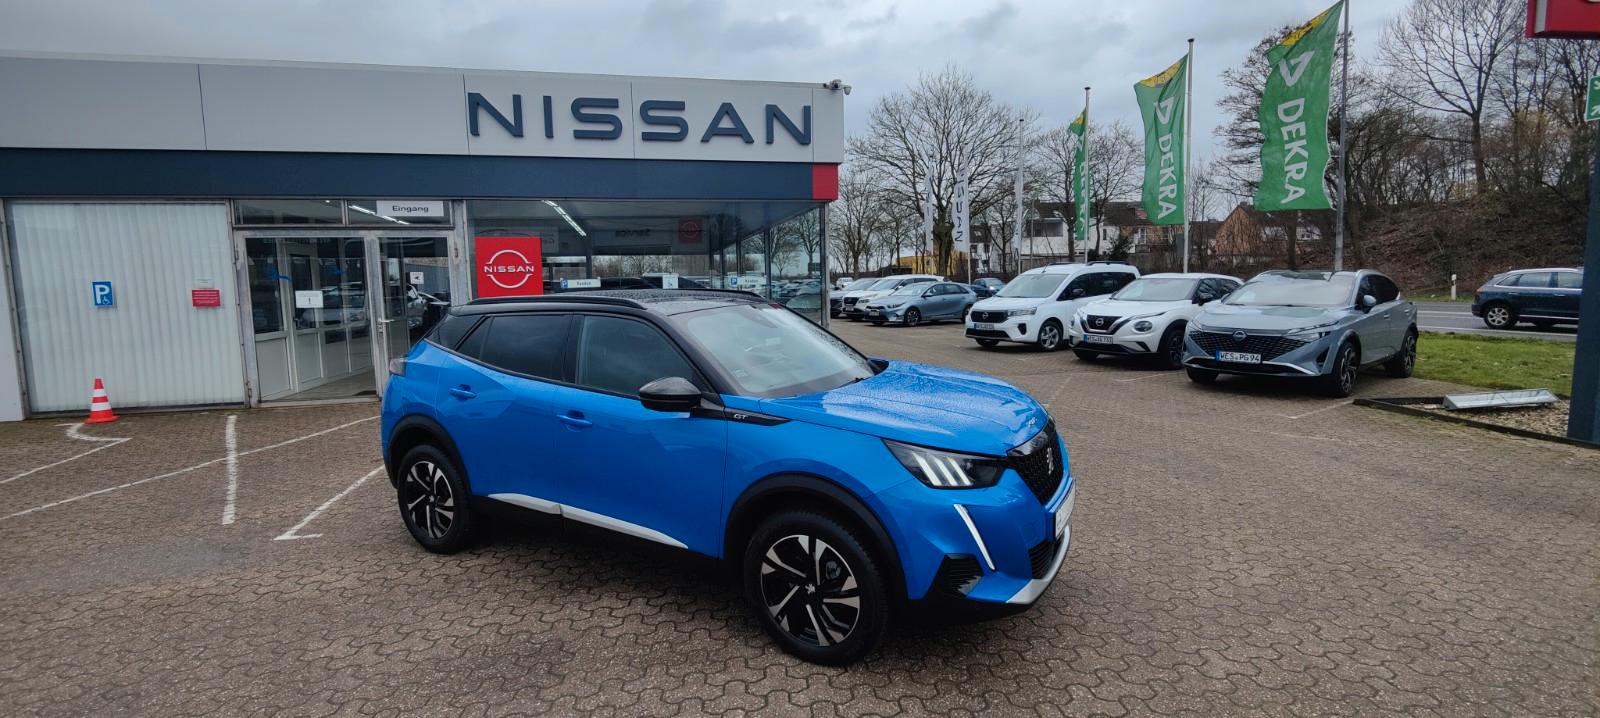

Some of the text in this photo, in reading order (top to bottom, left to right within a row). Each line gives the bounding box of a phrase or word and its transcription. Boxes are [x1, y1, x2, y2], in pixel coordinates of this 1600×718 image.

[467, 92, 812, 146] NISSAN
[1276, 97, 1309, 205] DEKRA
[1158, 132, 1178, 220] DEKRA
[392, 205, 429, 213] Eingang
[483, 265, 535, 273] NISSAN
[94, 284, 110, 304] P
